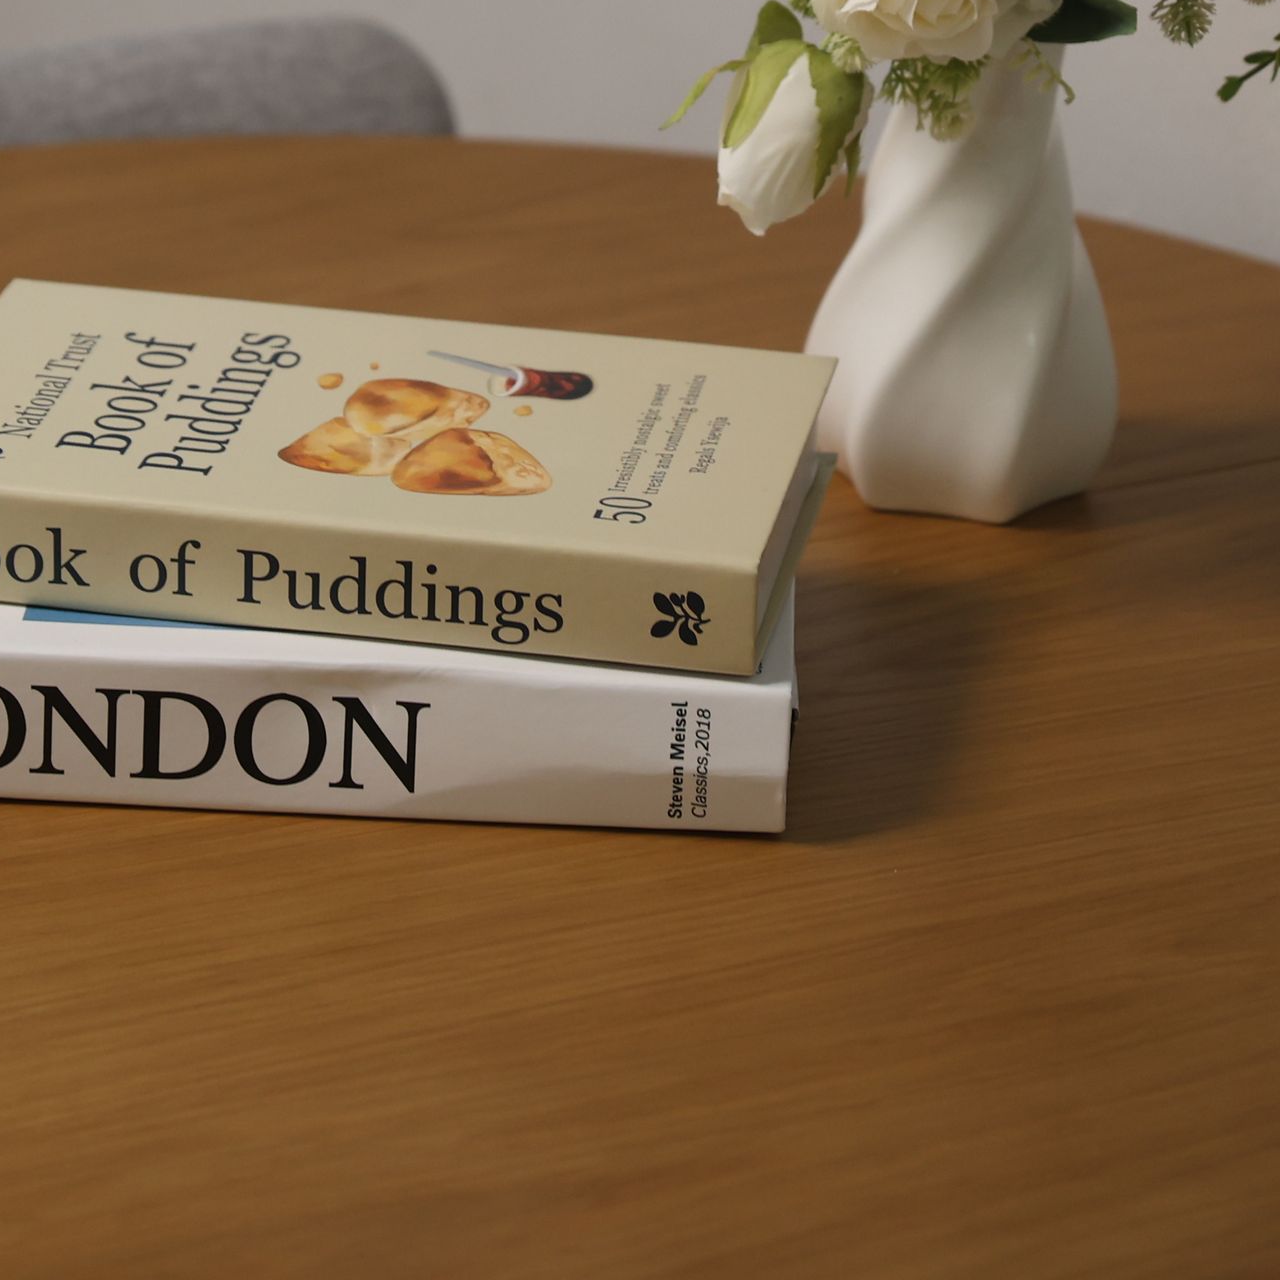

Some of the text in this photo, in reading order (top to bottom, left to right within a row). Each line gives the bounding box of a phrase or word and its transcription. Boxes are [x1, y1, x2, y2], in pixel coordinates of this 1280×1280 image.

[44, 331, 102, 371] Trust
[55, 331, 197, 455] Book of
[138, 332, 302, 477] Puddings
[593, 496, 653, 525] 50
[642, 471, 667, 495] treats
[655, 452, 674, 469] and
[129, 539, 202, 597] of
[236, 549, 566, 645] Puddings
[667, 701, 688, 820] Steven Meisel
